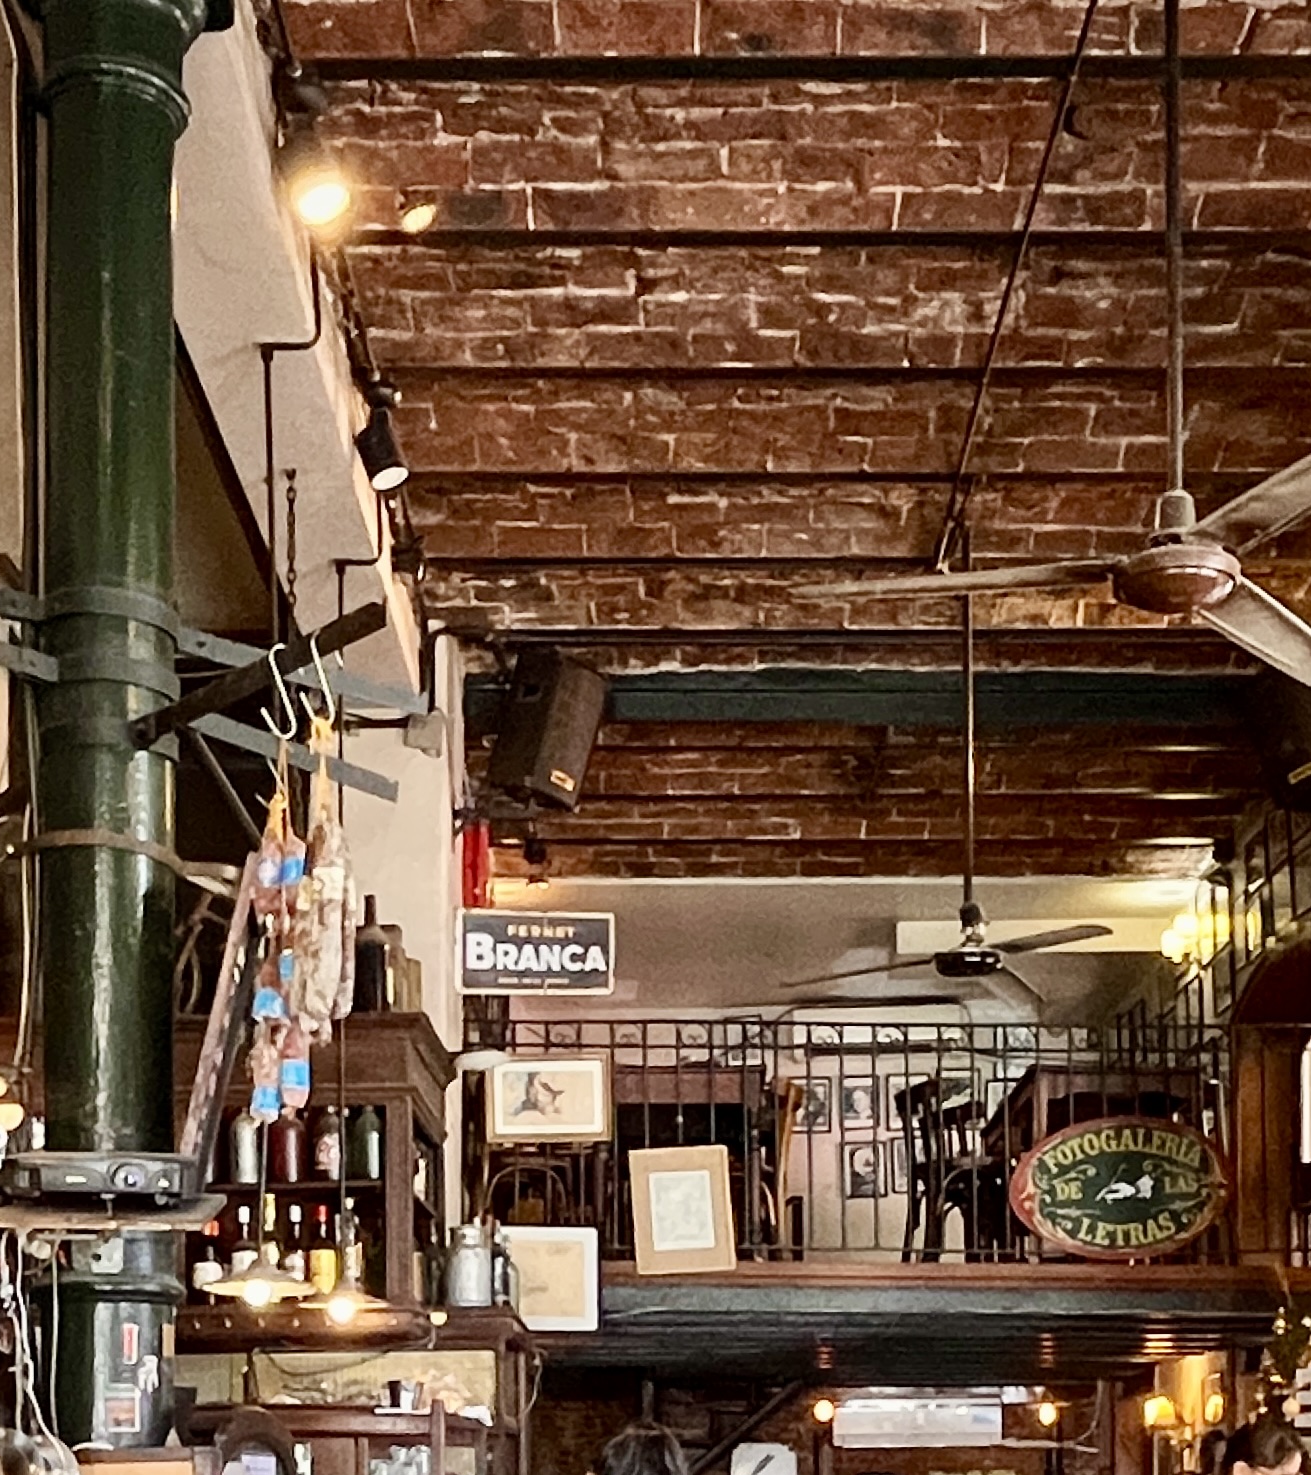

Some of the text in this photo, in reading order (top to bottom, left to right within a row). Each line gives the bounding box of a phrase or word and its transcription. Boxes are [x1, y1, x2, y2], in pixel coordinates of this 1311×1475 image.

[465, 931, 608, 972] BRANCA
[1055, 1175, 1199, 1200] DE LAS
[1076, 1210, 1176, 1246] LETRAS
